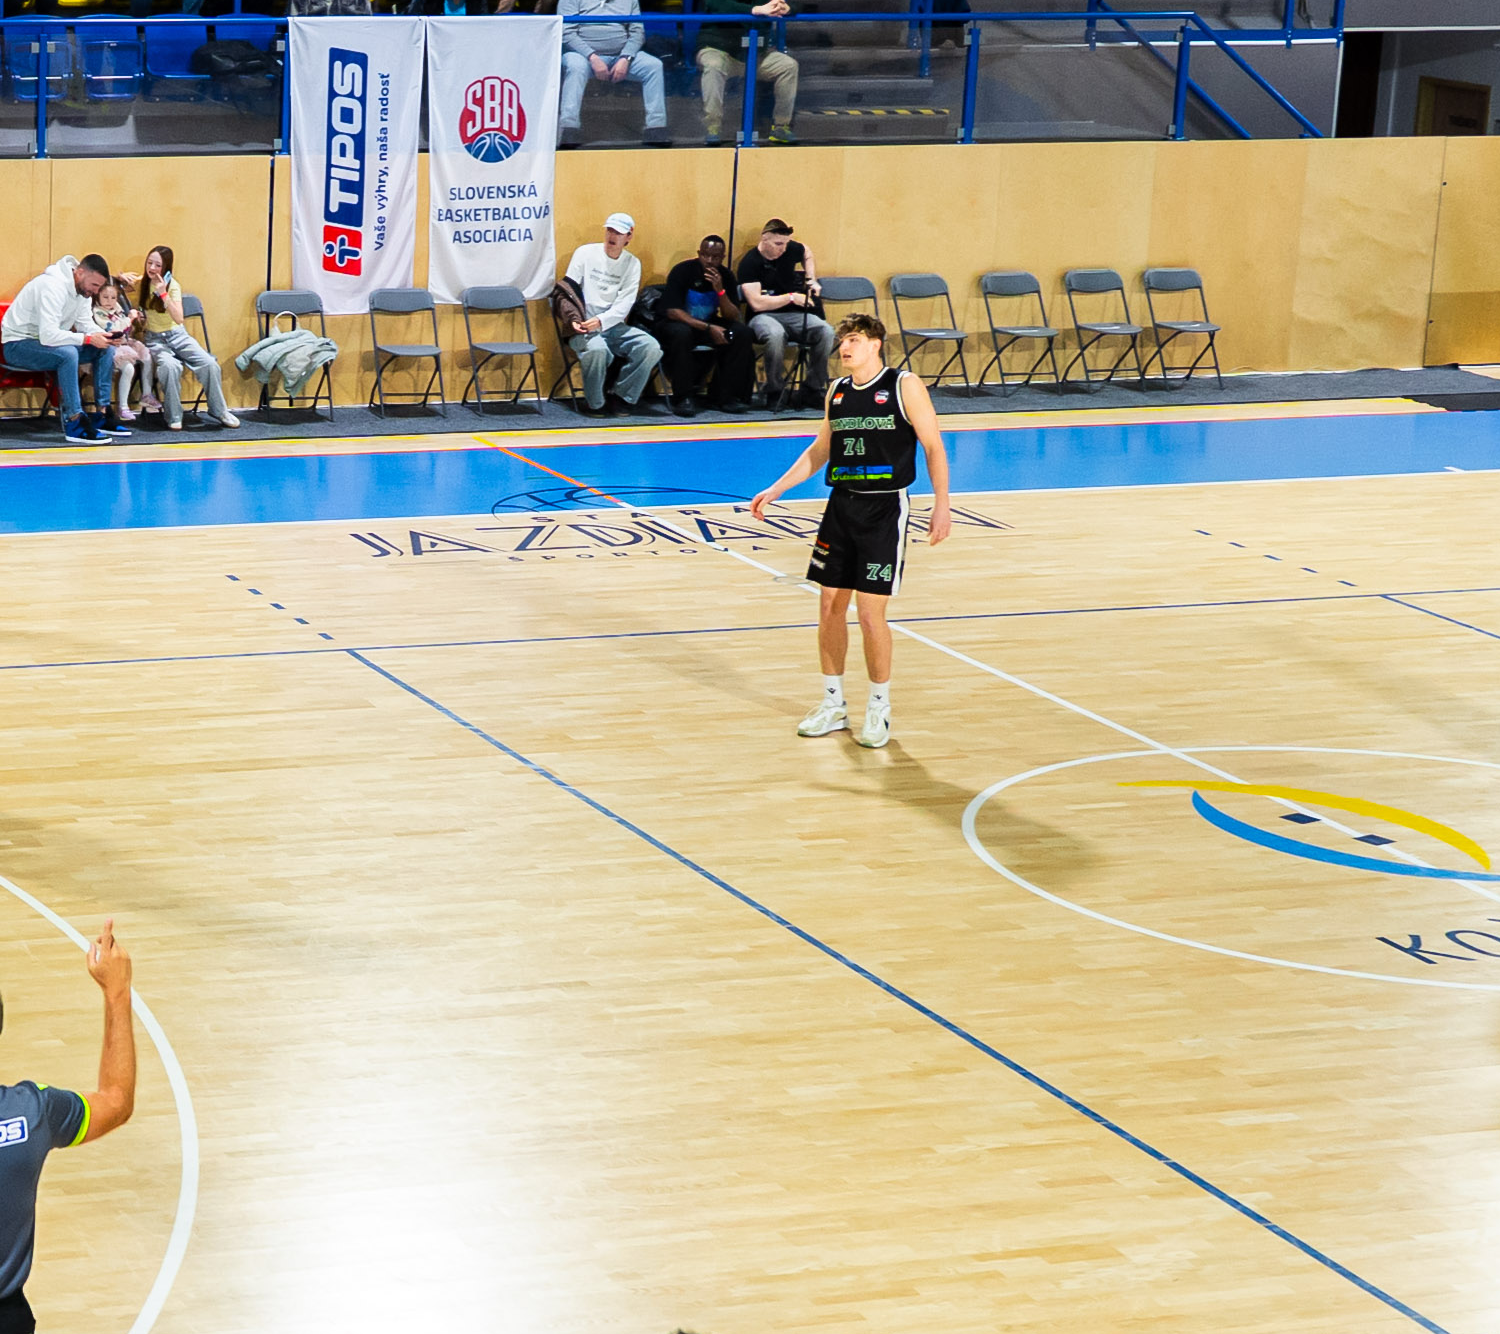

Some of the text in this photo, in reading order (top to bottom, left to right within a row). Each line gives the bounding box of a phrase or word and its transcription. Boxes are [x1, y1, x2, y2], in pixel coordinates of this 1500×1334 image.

[467, 76, 519, 136] SBA
[328, 60, 363, 214] TIPOS
[374, 73, 390, 251] Vaše výhry, naša radosť
[449, 181, 537, 201] SLOVENSKÁ
[437, 202, 550, 222] BASKETBALOVÁ
[452, 226, 533, 244] ASOCIÁCIA
[843, 438, 866, 456] 74
[866, 563, 893, 582] 74
